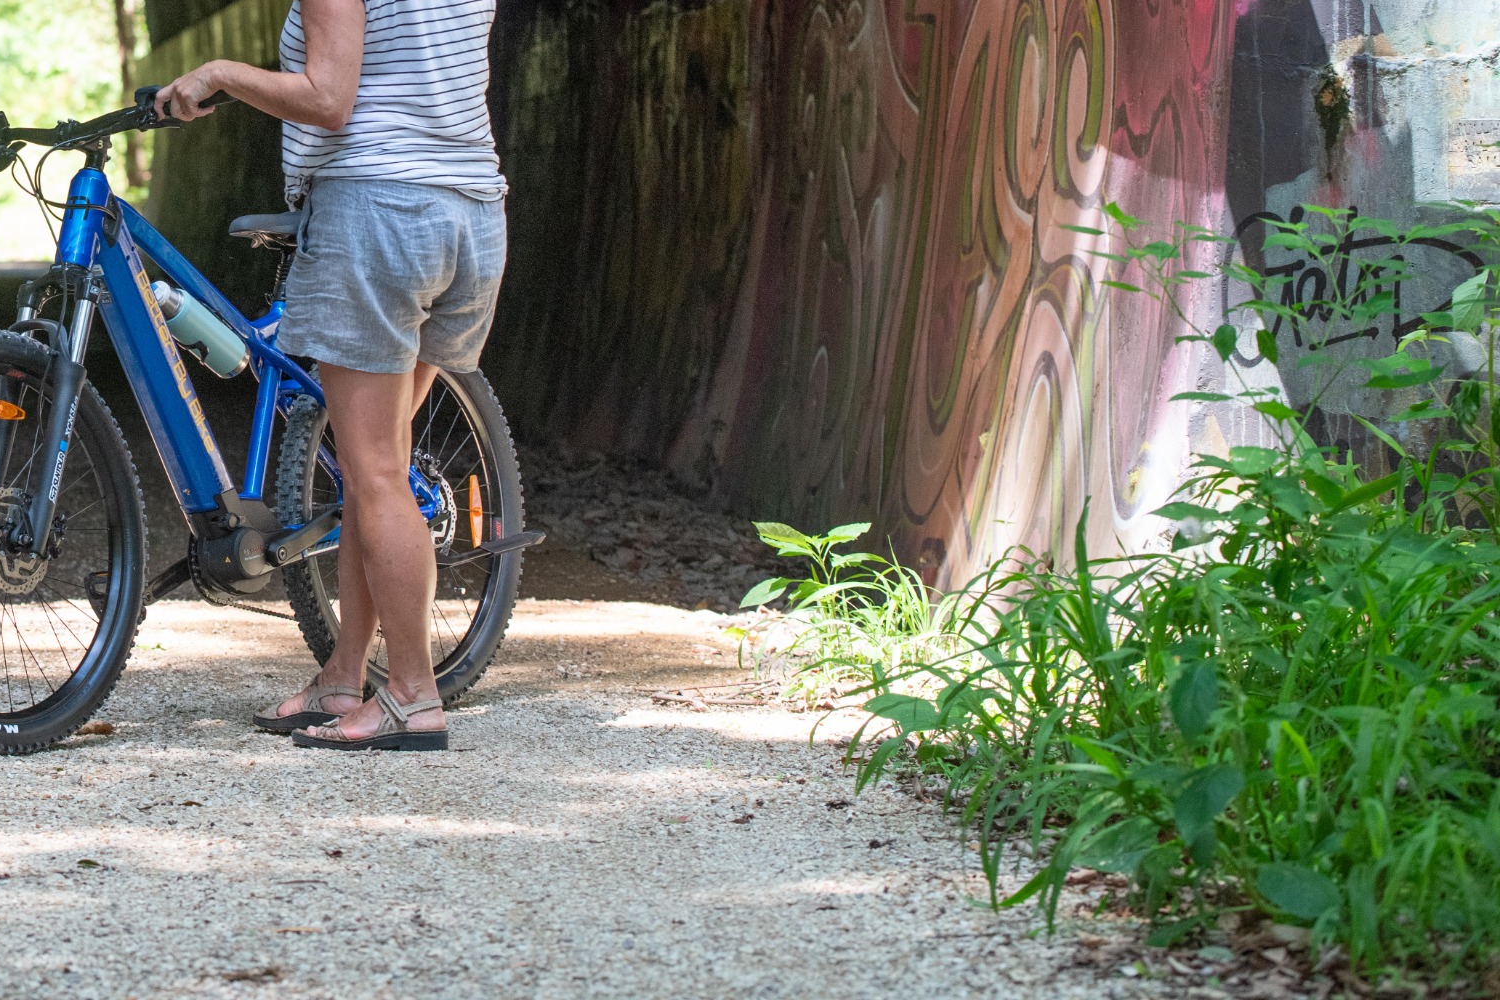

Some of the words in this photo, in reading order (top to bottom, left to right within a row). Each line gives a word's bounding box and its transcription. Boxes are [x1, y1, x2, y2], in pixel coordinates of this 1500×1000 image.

[136, 269, 177, 357] Better
[173, 359, 192, 399] By
[189, 397, 215, 456] Bike
